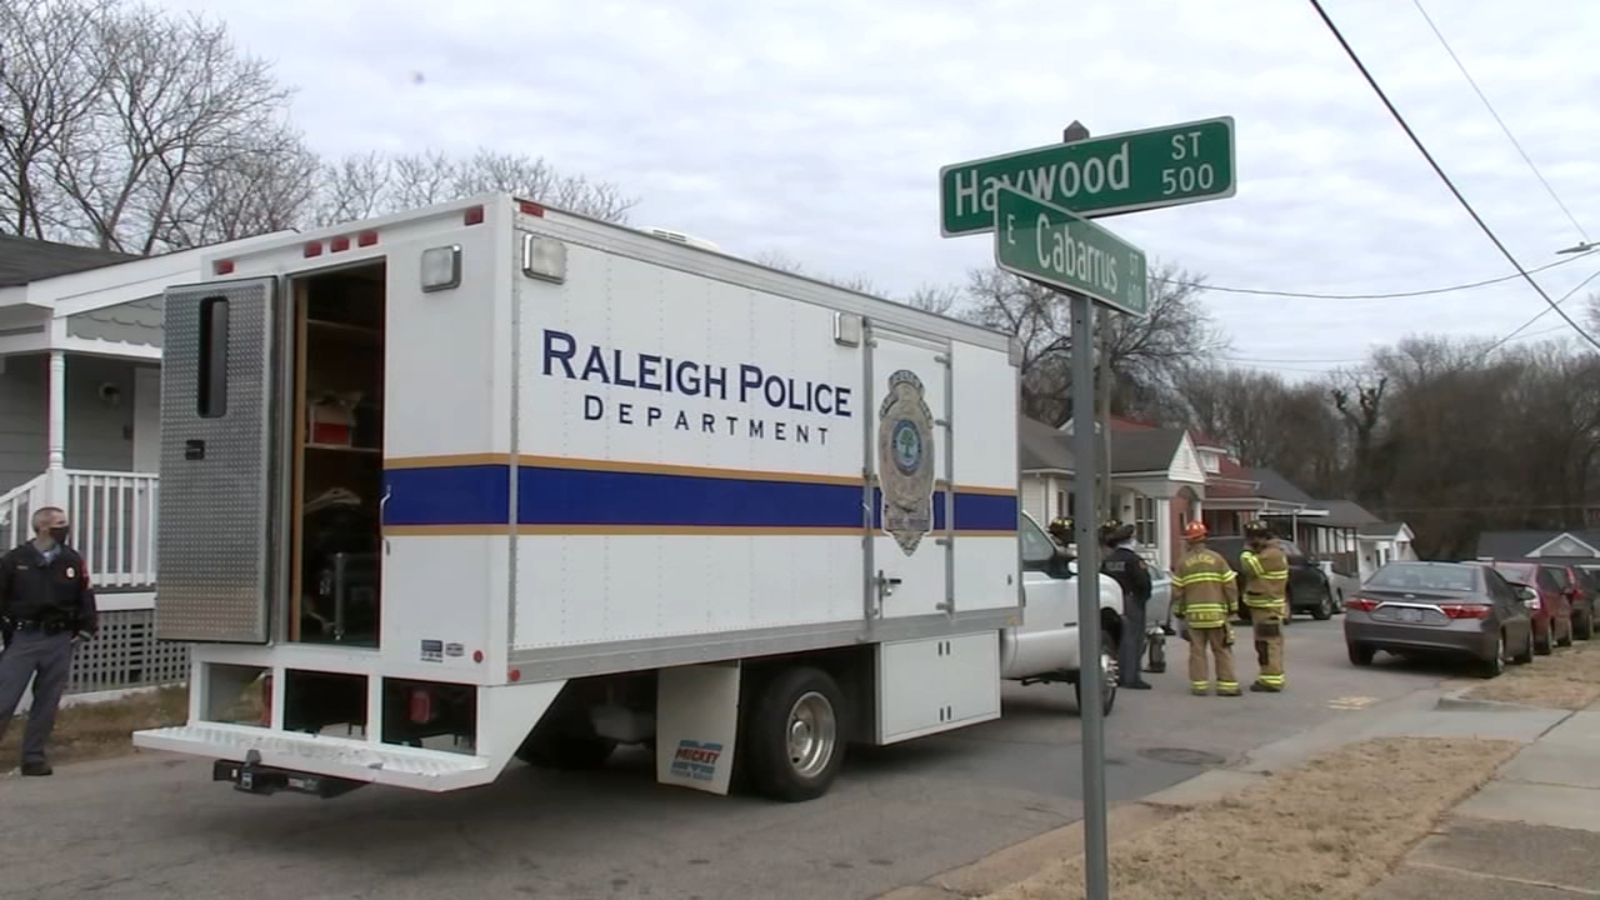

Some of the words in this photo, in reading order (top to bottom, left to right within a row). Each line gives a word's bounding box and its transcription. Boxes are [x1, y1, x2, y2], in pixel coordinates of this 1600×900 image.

[1171, 131, 1201, 160] ST
[1162, 163, 1214, 195] 500
[1007, 213, 1016, 245] E
[1036, 212, 1118, 295] Cabarrus
[542, 328, 728, 400] RALEIGH
[739, 363, 852, 417] POLICE
[583, 394, 828, 445] DEPARTMENT
